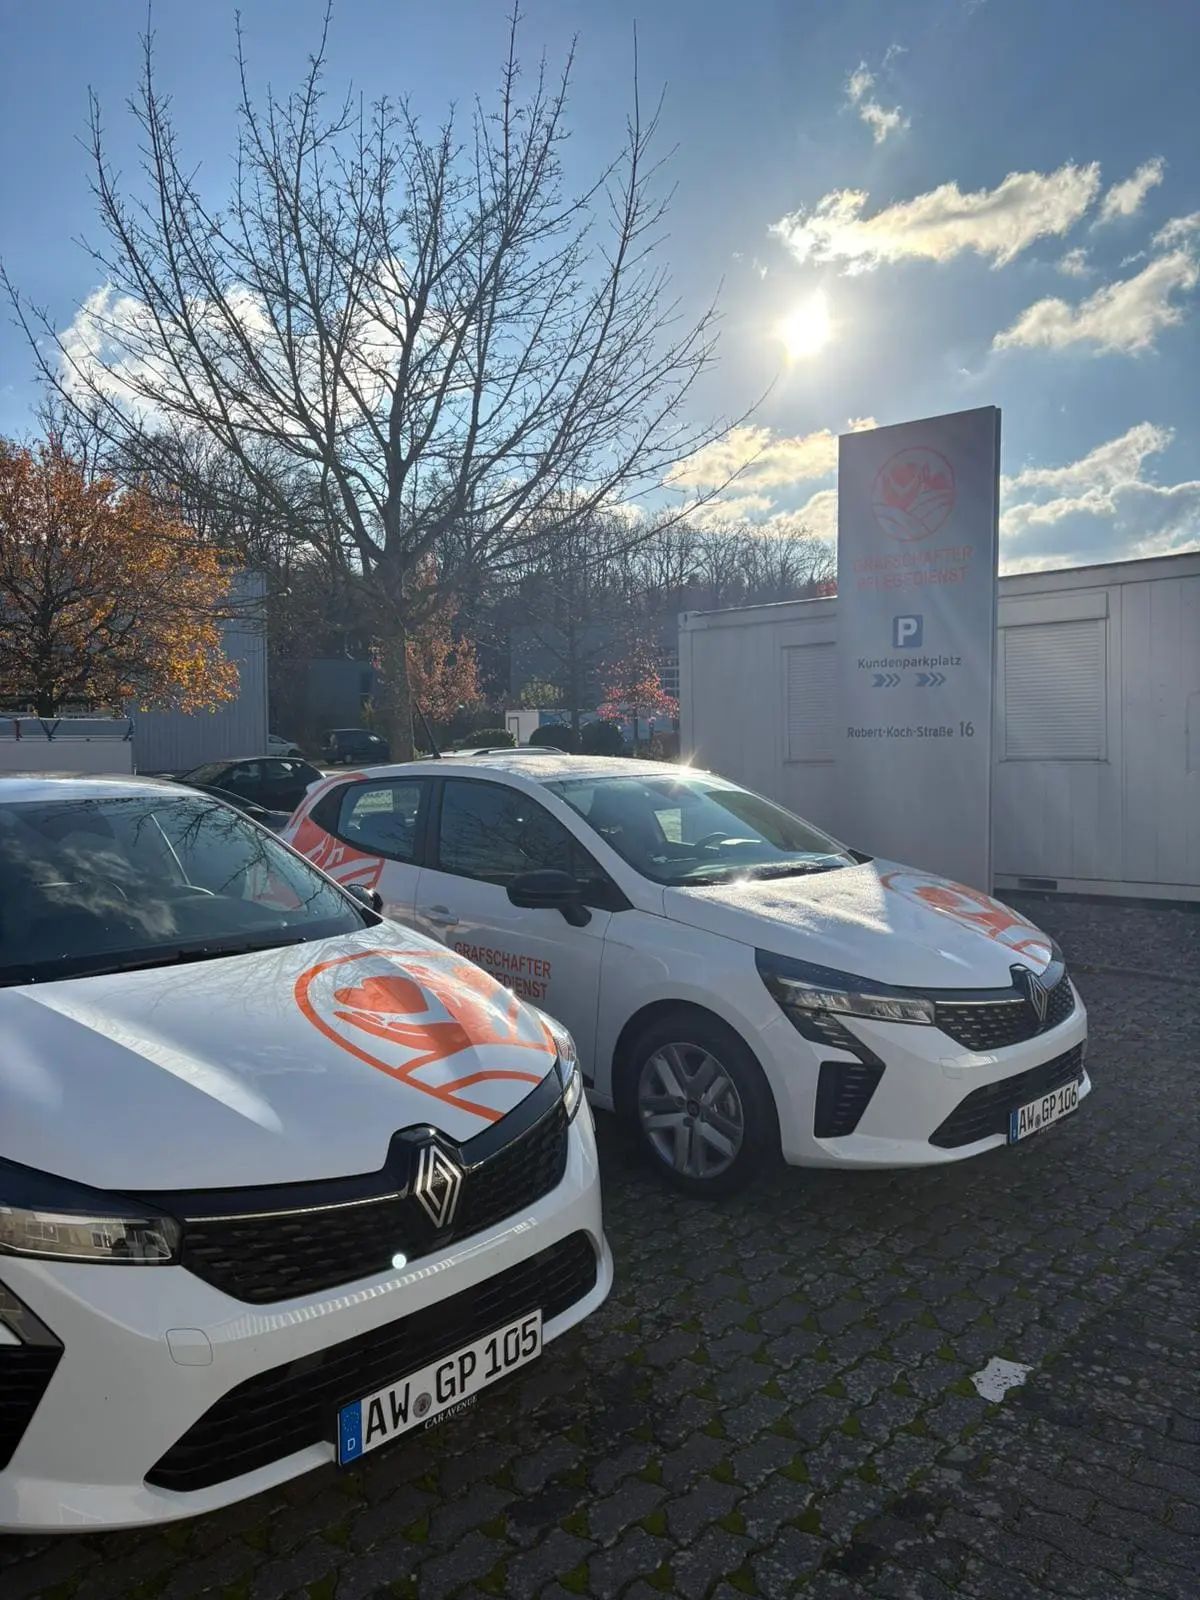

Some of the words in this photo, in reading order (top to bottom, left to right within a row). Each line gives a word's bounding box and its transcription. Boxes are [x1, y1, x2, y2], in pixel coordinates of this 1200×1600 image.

[854, 545, 973, 572] GRAFSCHAFTER
[897, 618, 918, 645] P
[858, 655, 962, 669] Kundenparkplatz
[847, 726, 953, 738] Robert-Koch-Straße
[959, 721, 974, 738] 16
[1019, 1104, 1035, 1135] AW
[1042, 1094, 1056, 1122] GP
[1058, 1084, 1077, 1114] 106
[347, 1437, 356, 1451] D
[366, 1382, 410, 1444] AW
[435, 1350, 476, 1404] GP
[485, 1316, 538, 1379] 105
